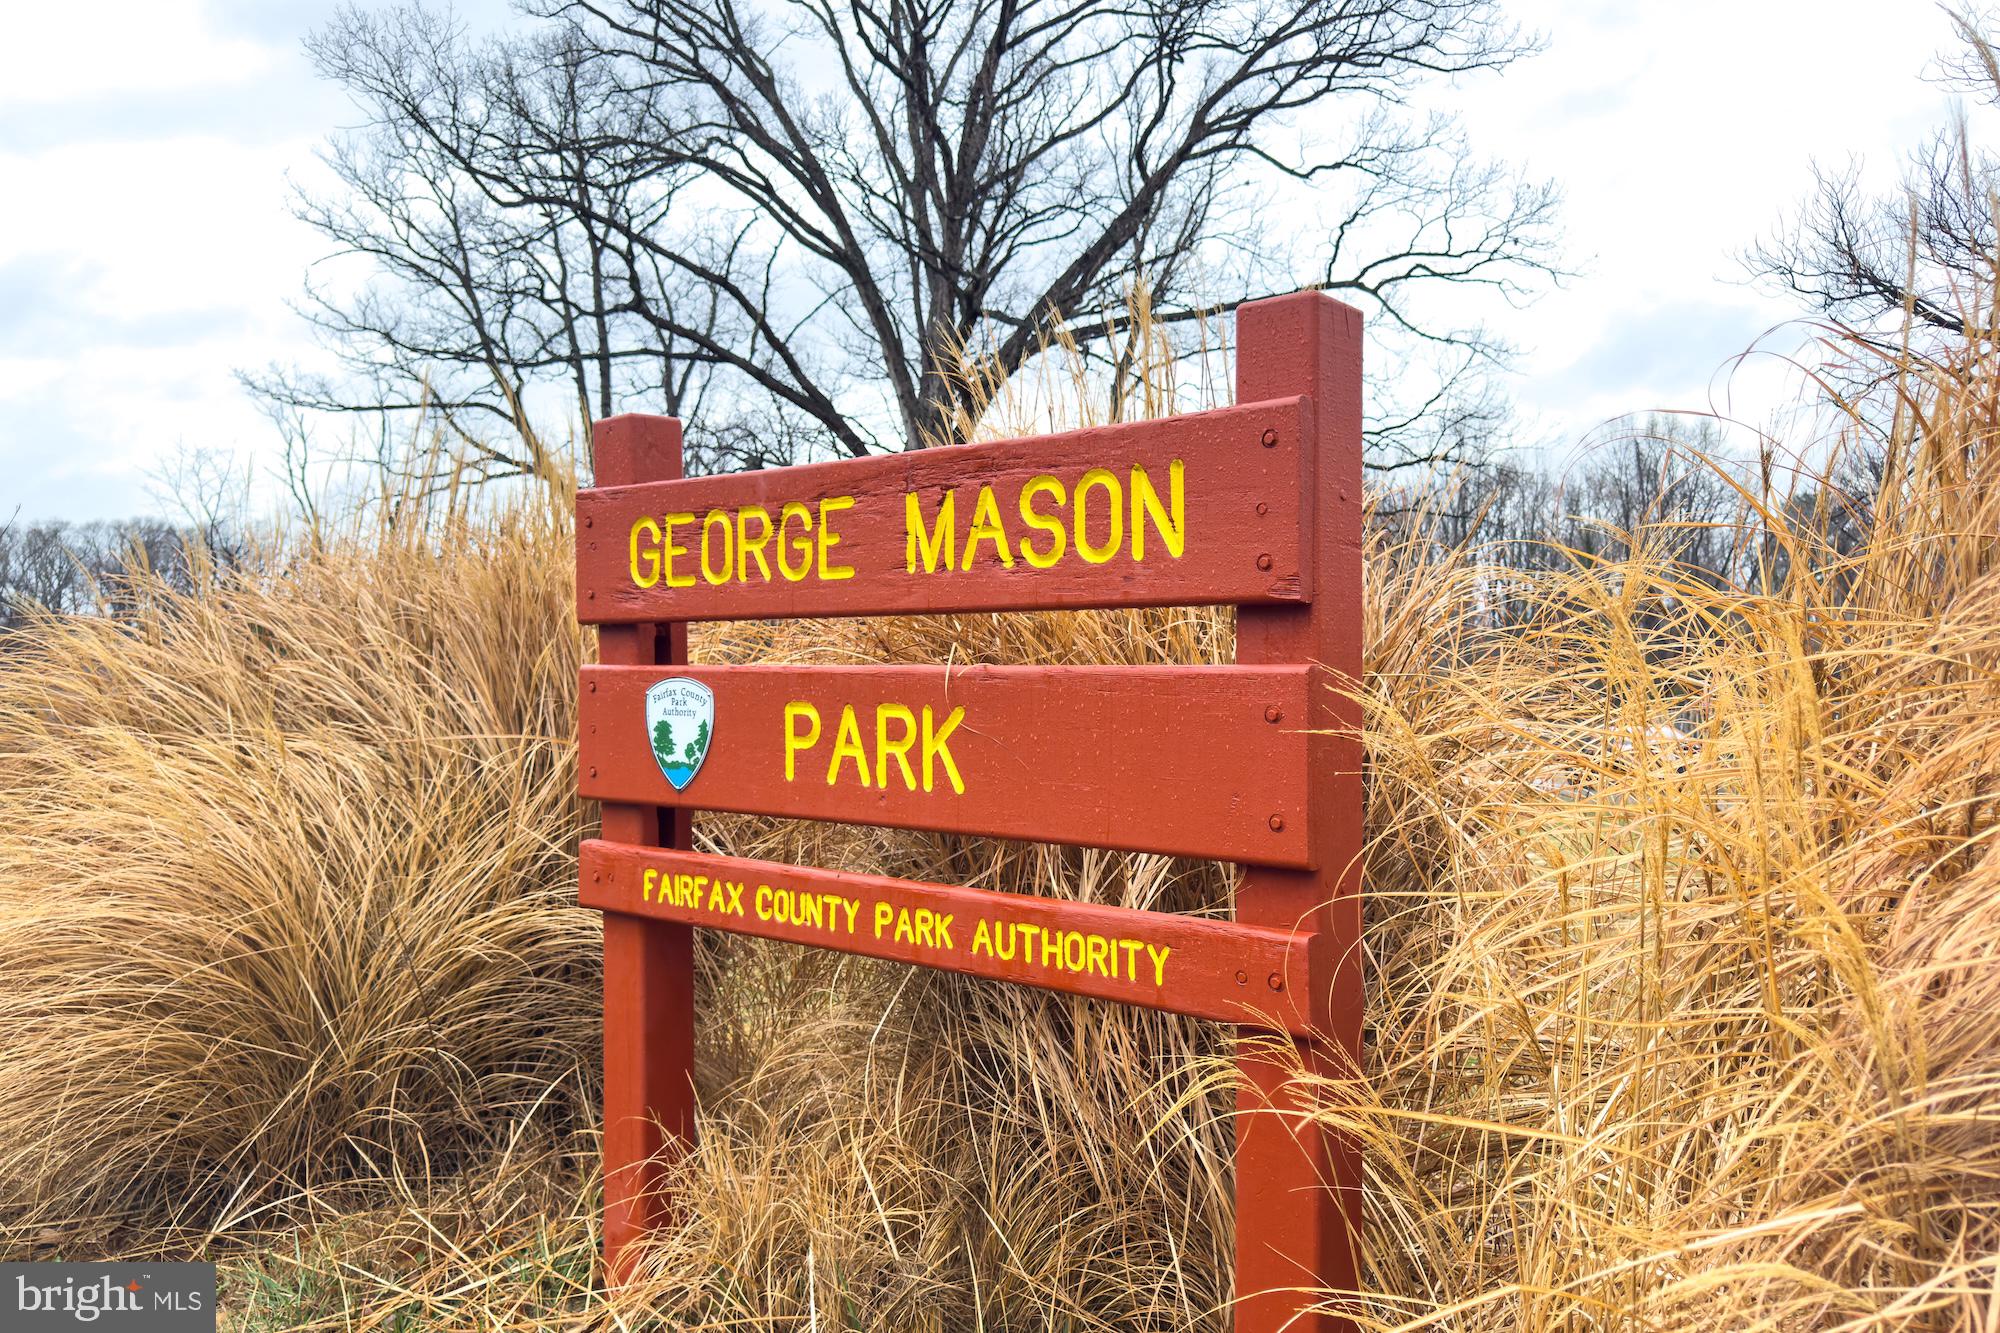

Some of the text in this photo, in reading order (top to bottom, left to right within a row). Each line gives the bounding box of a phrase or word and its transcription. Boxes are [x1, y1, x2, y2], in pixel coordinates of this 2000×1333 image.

[629, 459, 1185, 589] GEORGE MASON
[653, 688, 708, 707] Fairfax County
[662, 707, 697, 719] Authority
[671, 697, 688, 707] Park
[784, 701, 966, 795] PARK
[643, 868, 1170, 987] FAIRFAX COUNTY PARK AUTHORITY
